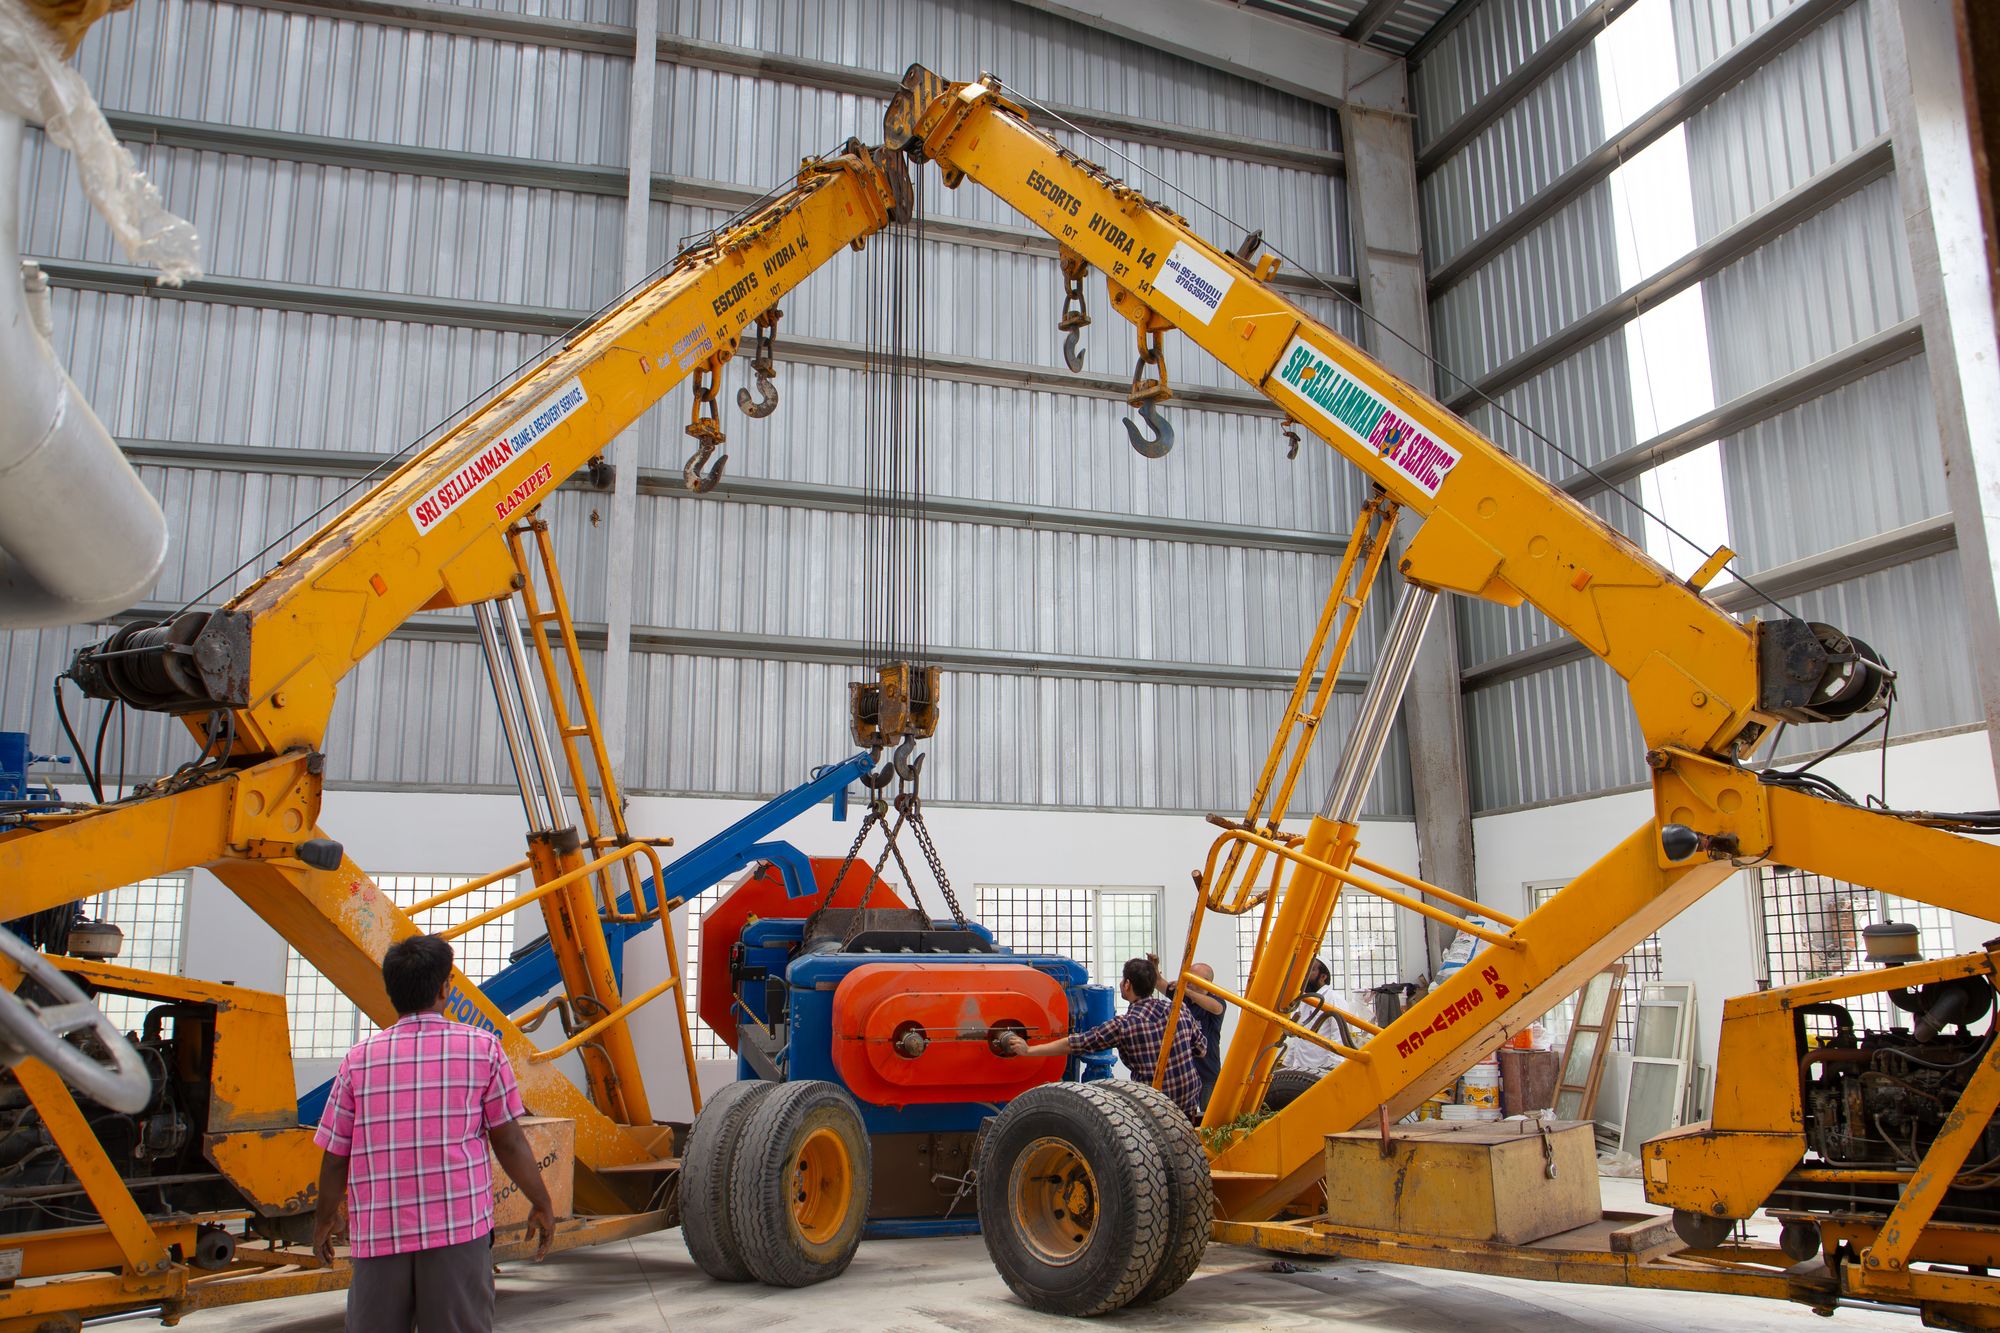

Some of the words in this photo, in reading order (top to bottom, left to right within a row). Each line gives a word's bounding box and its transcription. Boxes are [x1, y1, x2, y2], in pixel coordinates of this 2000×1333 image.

[1025, 169, 1082, 217] ESCORTS
[1088, 212, 1135, 256] HYDRA
[1136, 247, 1157, 270] 14
[1062, 223, 1078, 240] 10T
[712, 272, 758, 317] ESCORTS
[763, 243, 797, 277] HYDRA
[797, 234, 809, 252] 14
[1112, 260, 1130, 278] 12T
[769, 283, 782, 297] 10T
[1175, 274, 1218, 309] 9786350720
[735, 309, 749, 324] 12T
[1301, 360, 1387, 440] SELLIAMMAN
[415, 496, 442, 527] SRI
[437, 438, 513, 510] SELLIAMMAN
[510, 428, 532, 453] CRANE
[529, 424, 537, 438] &
[533, 402, 563, 434] RECOVERY
[559, 387, 583, 413] SERVICE
[495, 462, 553, 521] RANIPET
[1481, 965, 1510, 1000] 24
[1396, 988, 1483, 1059] SERVICE
[494, 1182, 518, 1204] TOO
